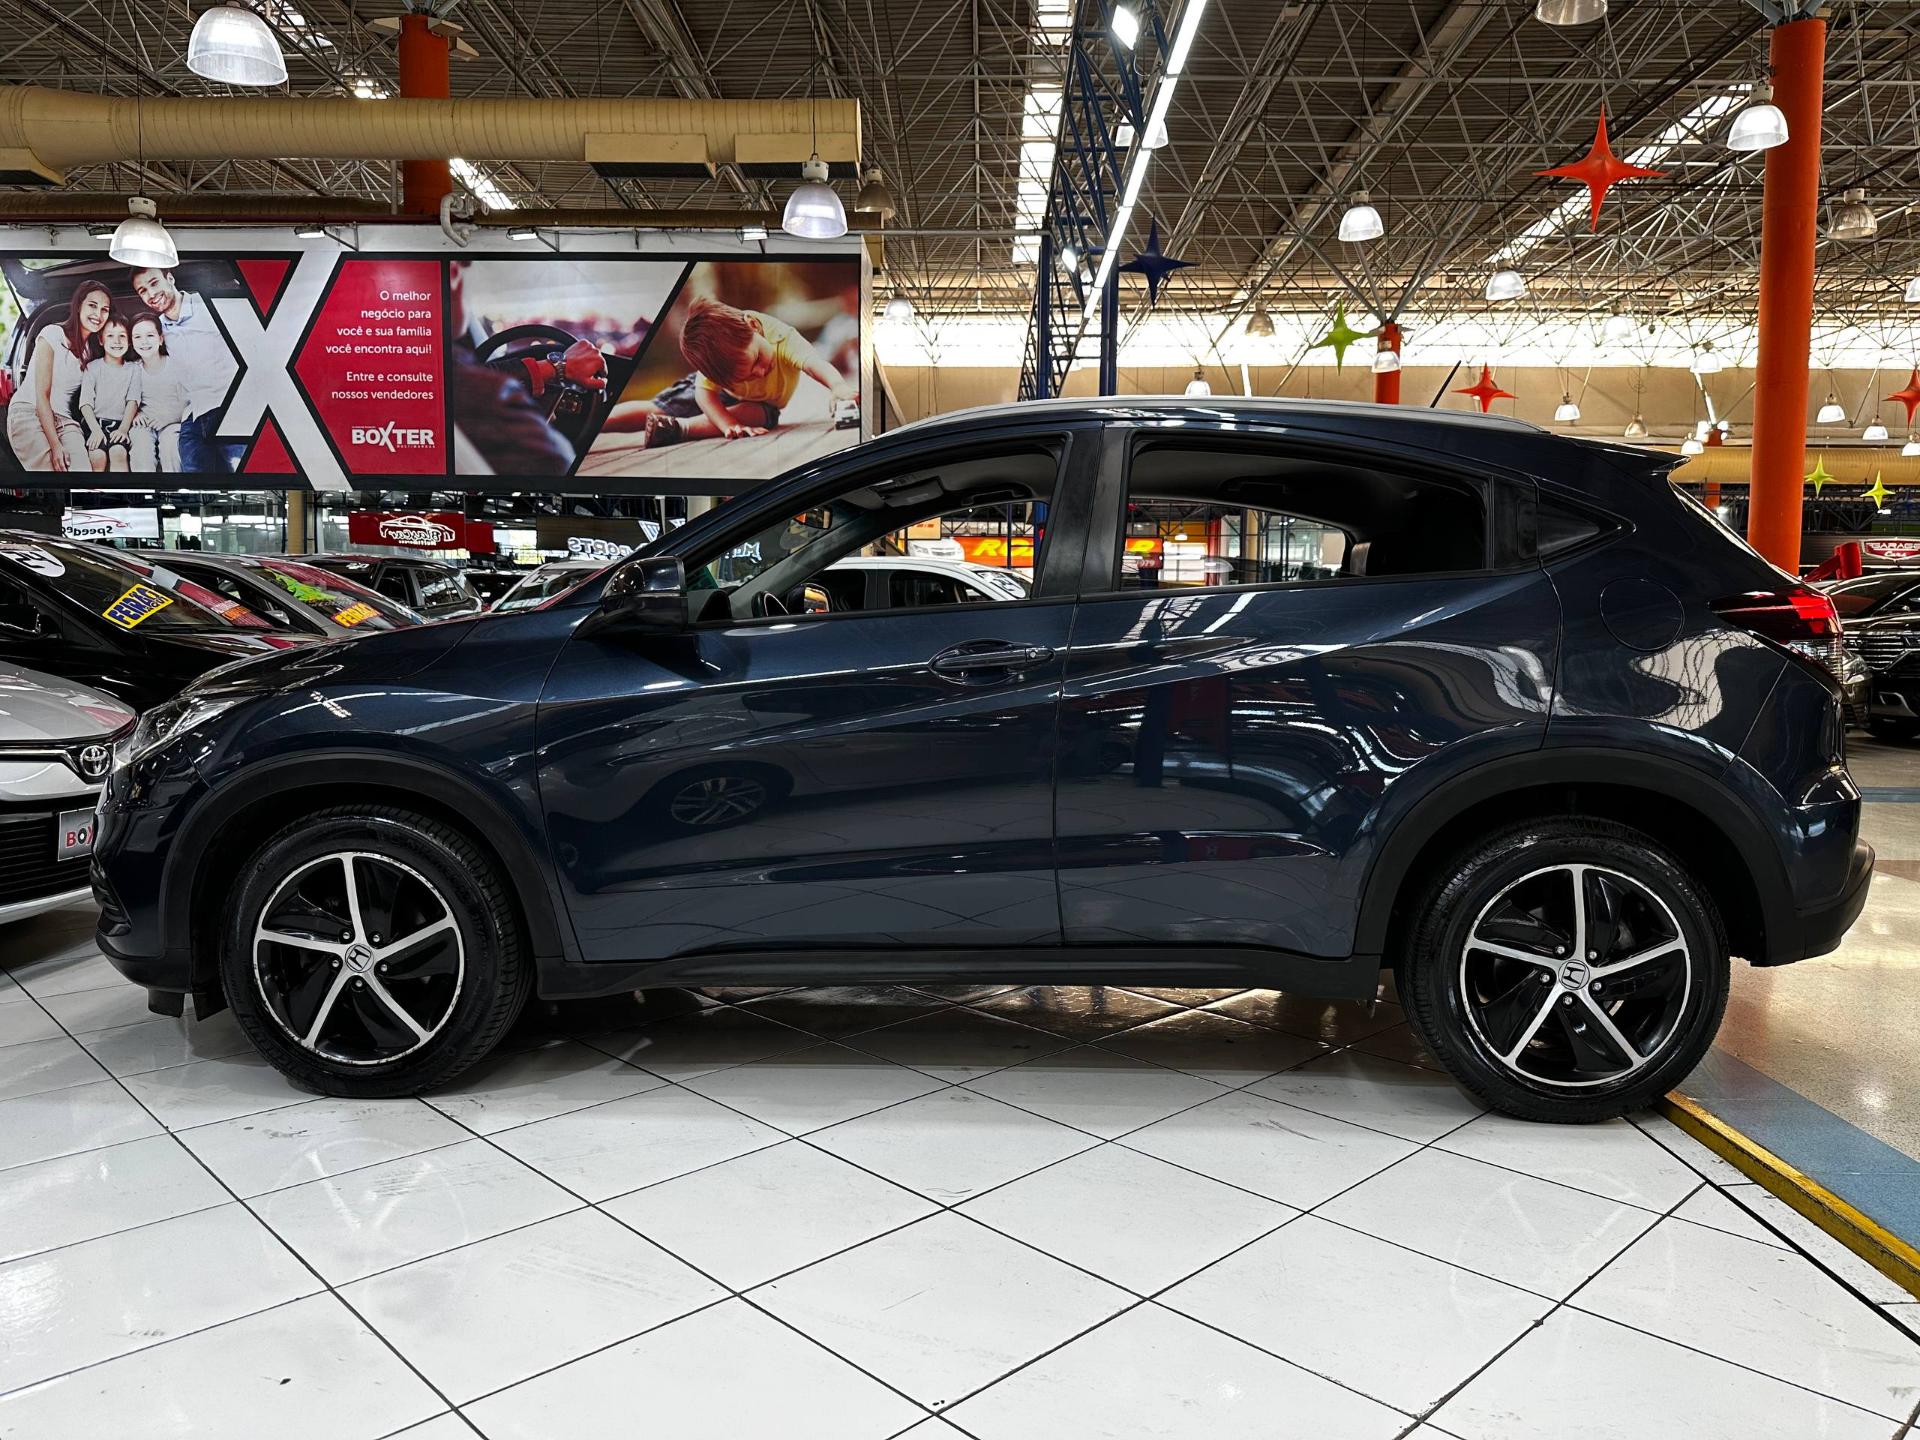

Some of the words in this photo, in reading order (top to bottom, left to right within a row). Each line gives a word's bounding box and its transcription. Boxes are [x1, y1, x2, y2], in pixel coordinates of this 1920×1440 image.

[380, 290, 390, 301] O
[392, 291, 432, 301] melhor
[361, 308, 405, 320] negócio
[408, 310, 432, 320] para
[336, 326, 363, 336] você
[365, 328, 373, 336] e
[375, 328, 393, 336] sua
[396, 326, 432, 336] família
[325, 343, 352, 354] você
[354, 345, 403, 354] encontra
[405, 344, 432, 356] aqui!
[346, 371, 375, 382] Entre
[377, 373, 385, 382] e
[386, 372, 433, 382] consulte
[331, 391, 369, 399] nossos
[370, 389, 434, 400] vendedores
[351, 421, 434, 452] BOXTER
